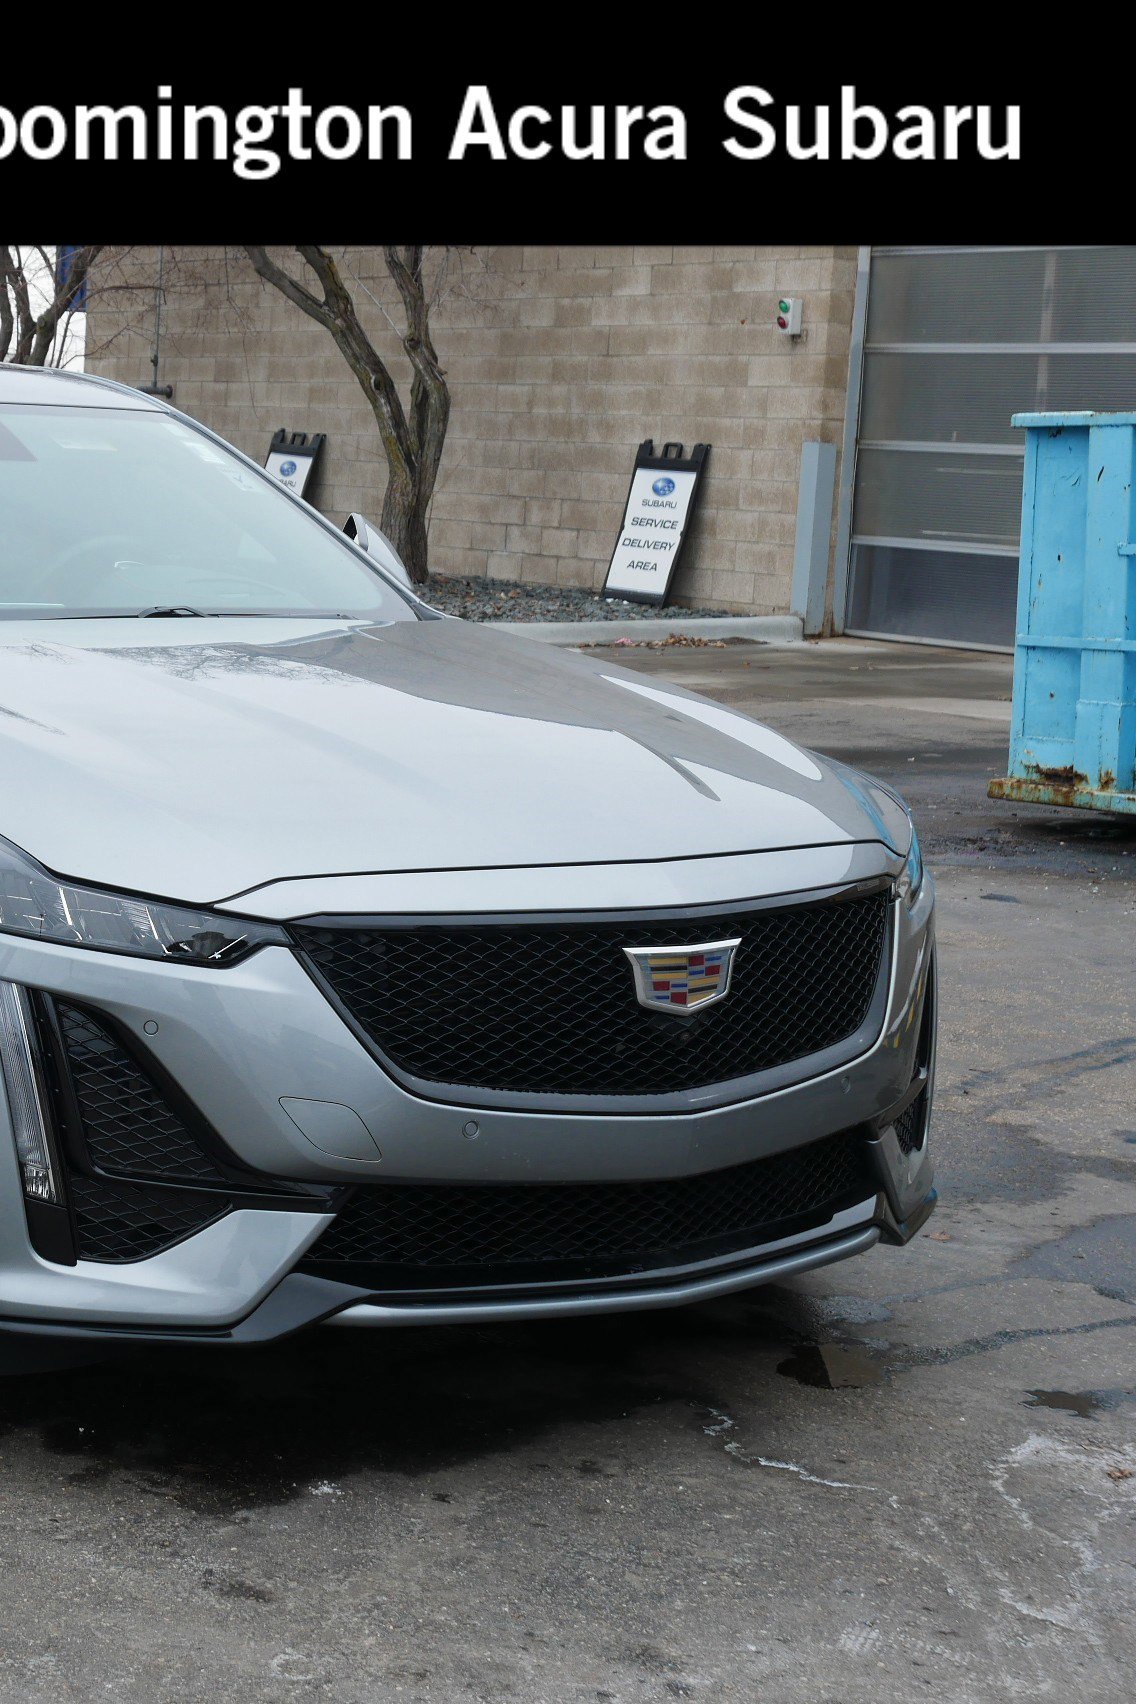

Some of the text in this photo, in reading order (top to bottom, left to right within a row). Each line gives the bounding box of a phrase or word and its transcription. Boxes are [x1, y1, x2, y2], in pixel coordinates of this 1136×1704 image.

[642, 499, 677, 509] SUBARU
[631, 517, 678, 529] SERVICE
[622, 537, 675, 551] DELIVERY
[627, 560, 657, 571] AREA
